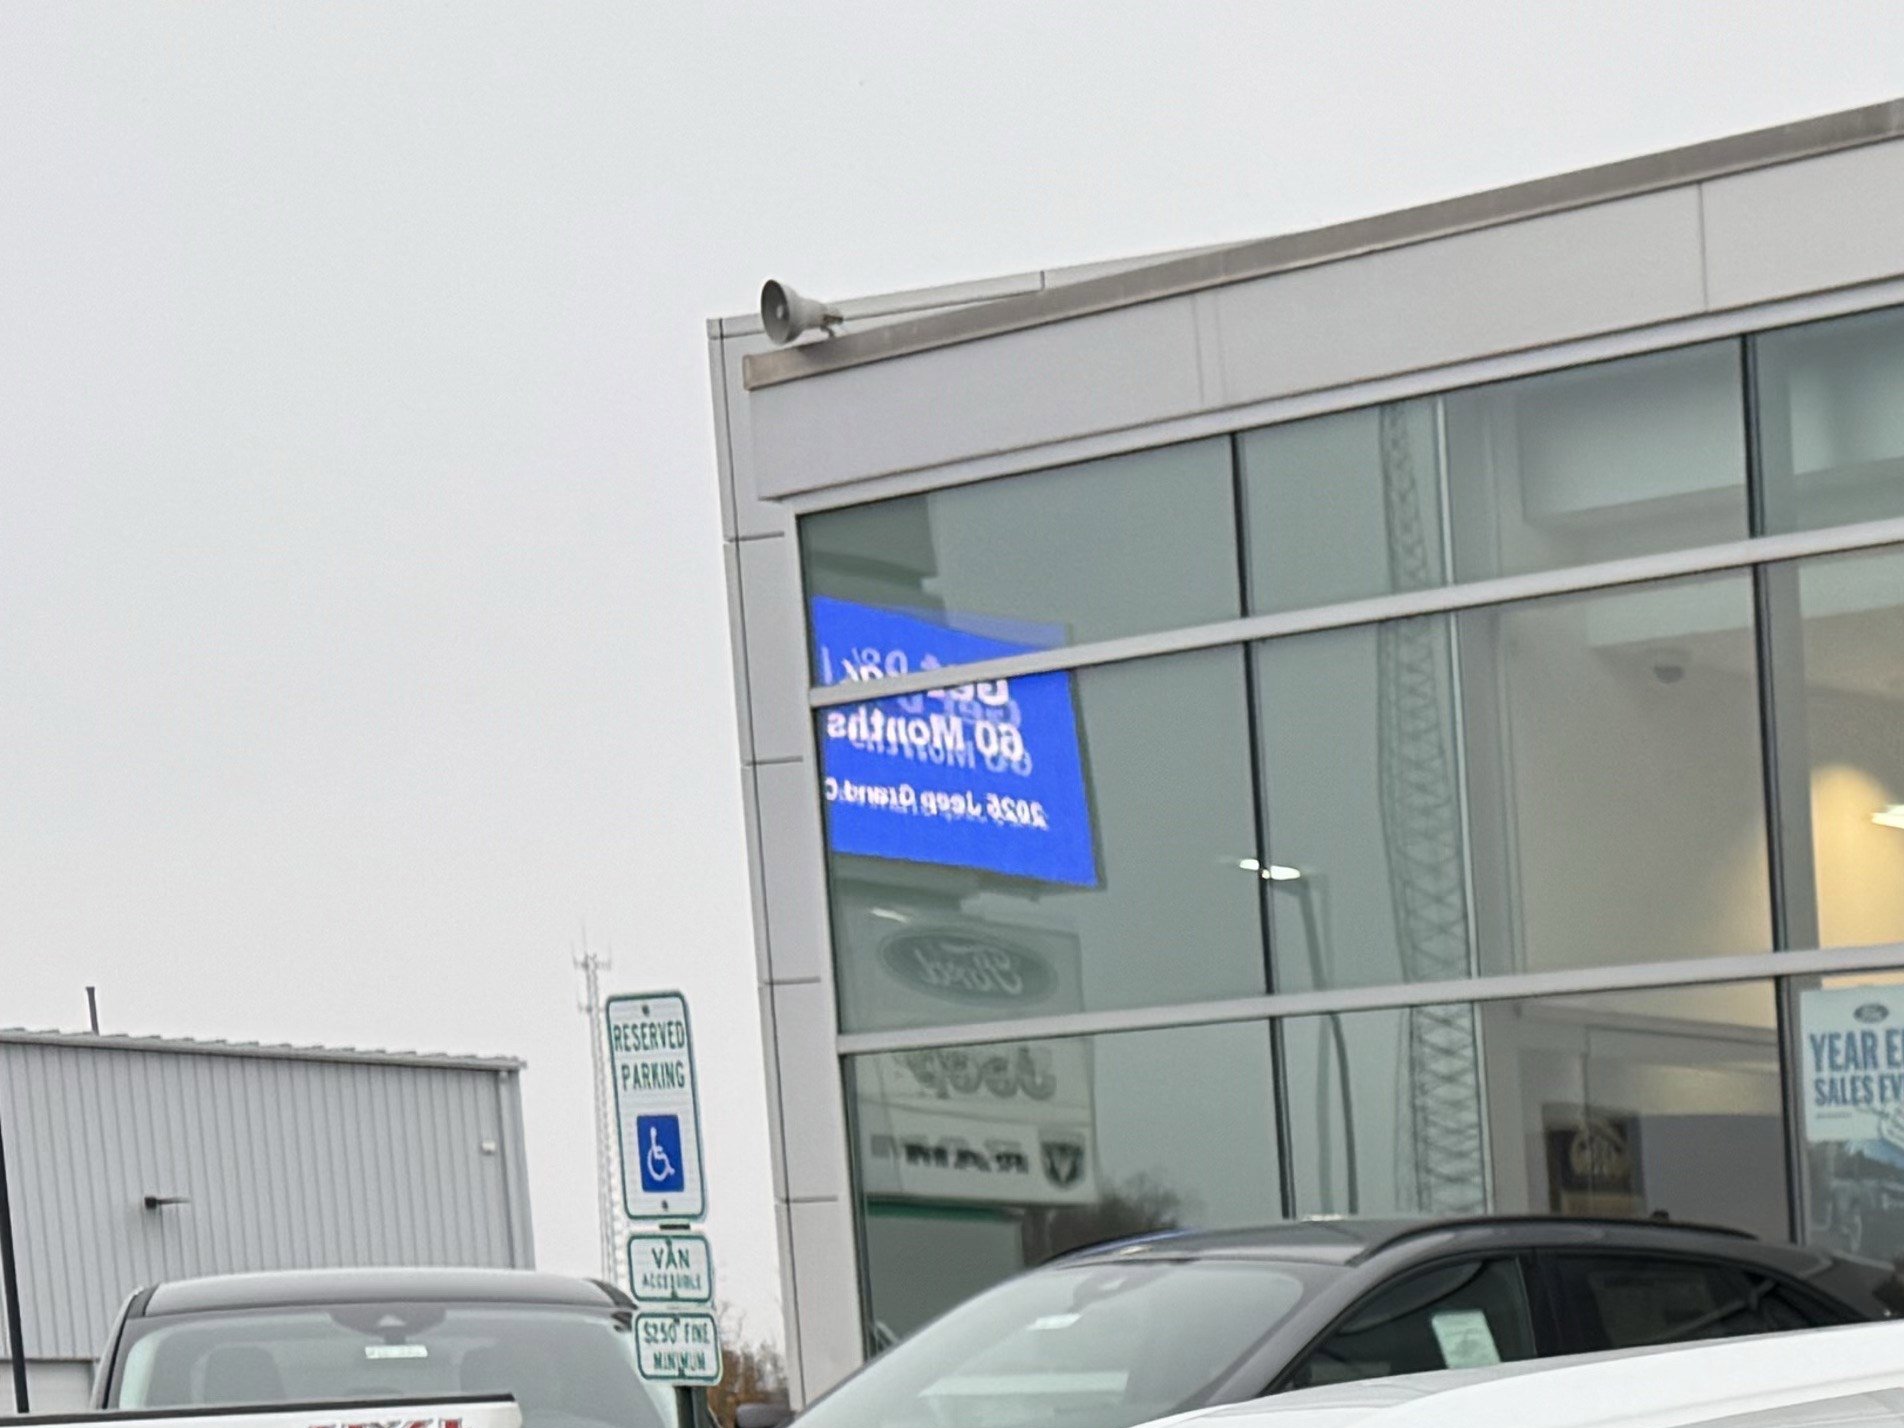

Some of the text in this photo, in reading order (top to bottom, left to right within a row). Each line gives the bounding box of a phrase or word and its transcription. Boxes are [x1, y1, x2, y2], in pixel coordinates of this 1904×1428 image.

[613, 1020, 686, 1052] RESERVED
[1809, 1030, 1880, 1073] YEAR
[621, 1060, 686, 1091] PARKING
[1814, 1074, 1875, 1106] SALES
[652, 1247, 691, 1269] VAN
